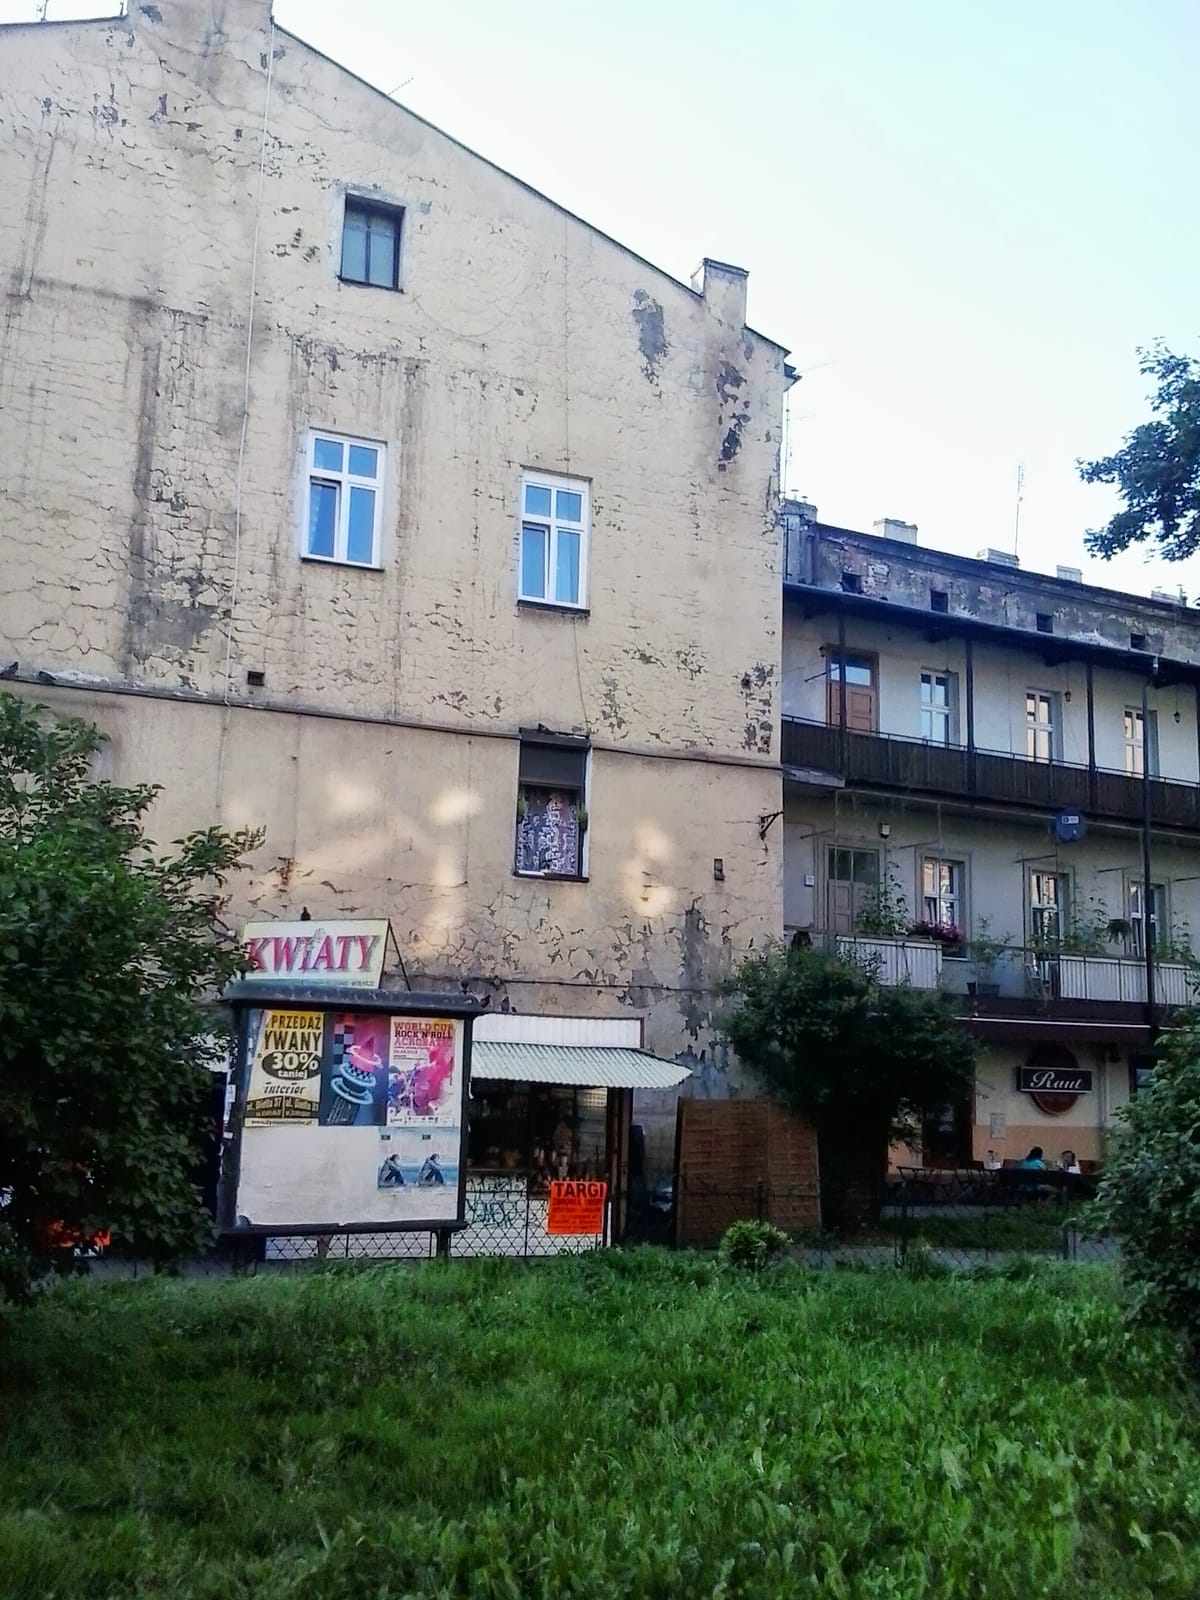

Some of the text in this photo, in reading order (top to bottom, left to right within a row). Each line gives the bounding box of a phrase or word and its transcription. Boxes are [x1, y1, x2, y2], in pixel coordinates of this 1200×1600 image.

[246, 935, 379, 971] KWIATY
[393, 1021, 454, 1032] WORLD CUP
[430, 1031, 453, 1039] ROLL
[271, 1052, 319, 1070] 30%
[278, 1069, 308, 1080] taniej
[1029, 1071, 1083, 1088] Raut
[263, 1081, 307, 1094] interior
[553, 1182, 604, 1198] TARGI
